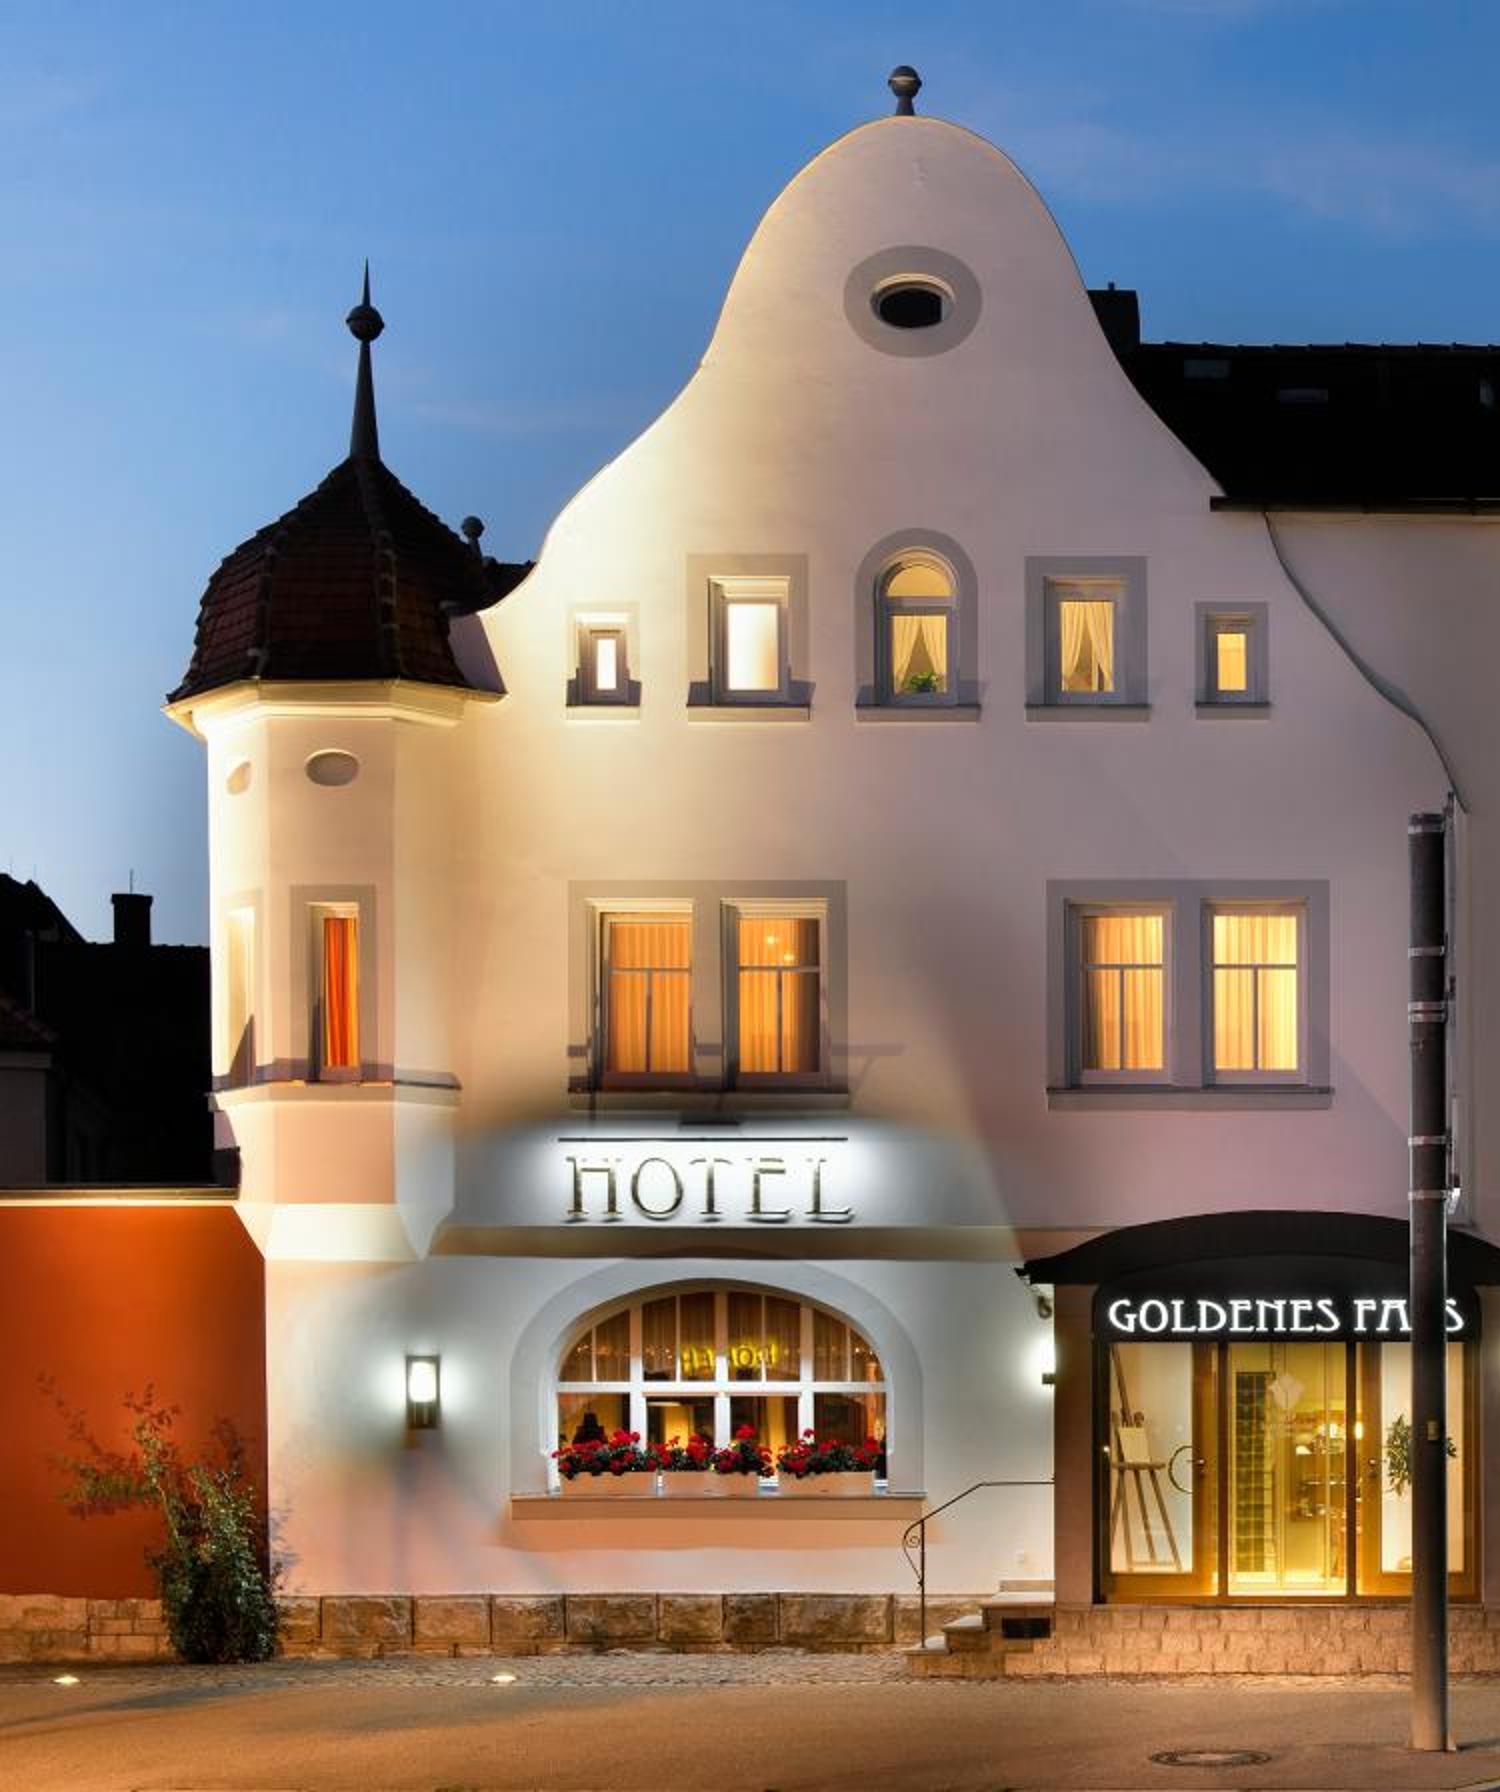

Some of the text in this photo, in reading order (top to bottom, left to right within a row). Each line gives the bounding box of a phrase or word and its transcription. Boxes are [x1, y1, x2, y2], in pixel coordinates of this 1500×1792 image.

[565, 1156, 854, 1222] HOTEL
[1108, 1299, 1464, 1333] GOLDENES FAS
